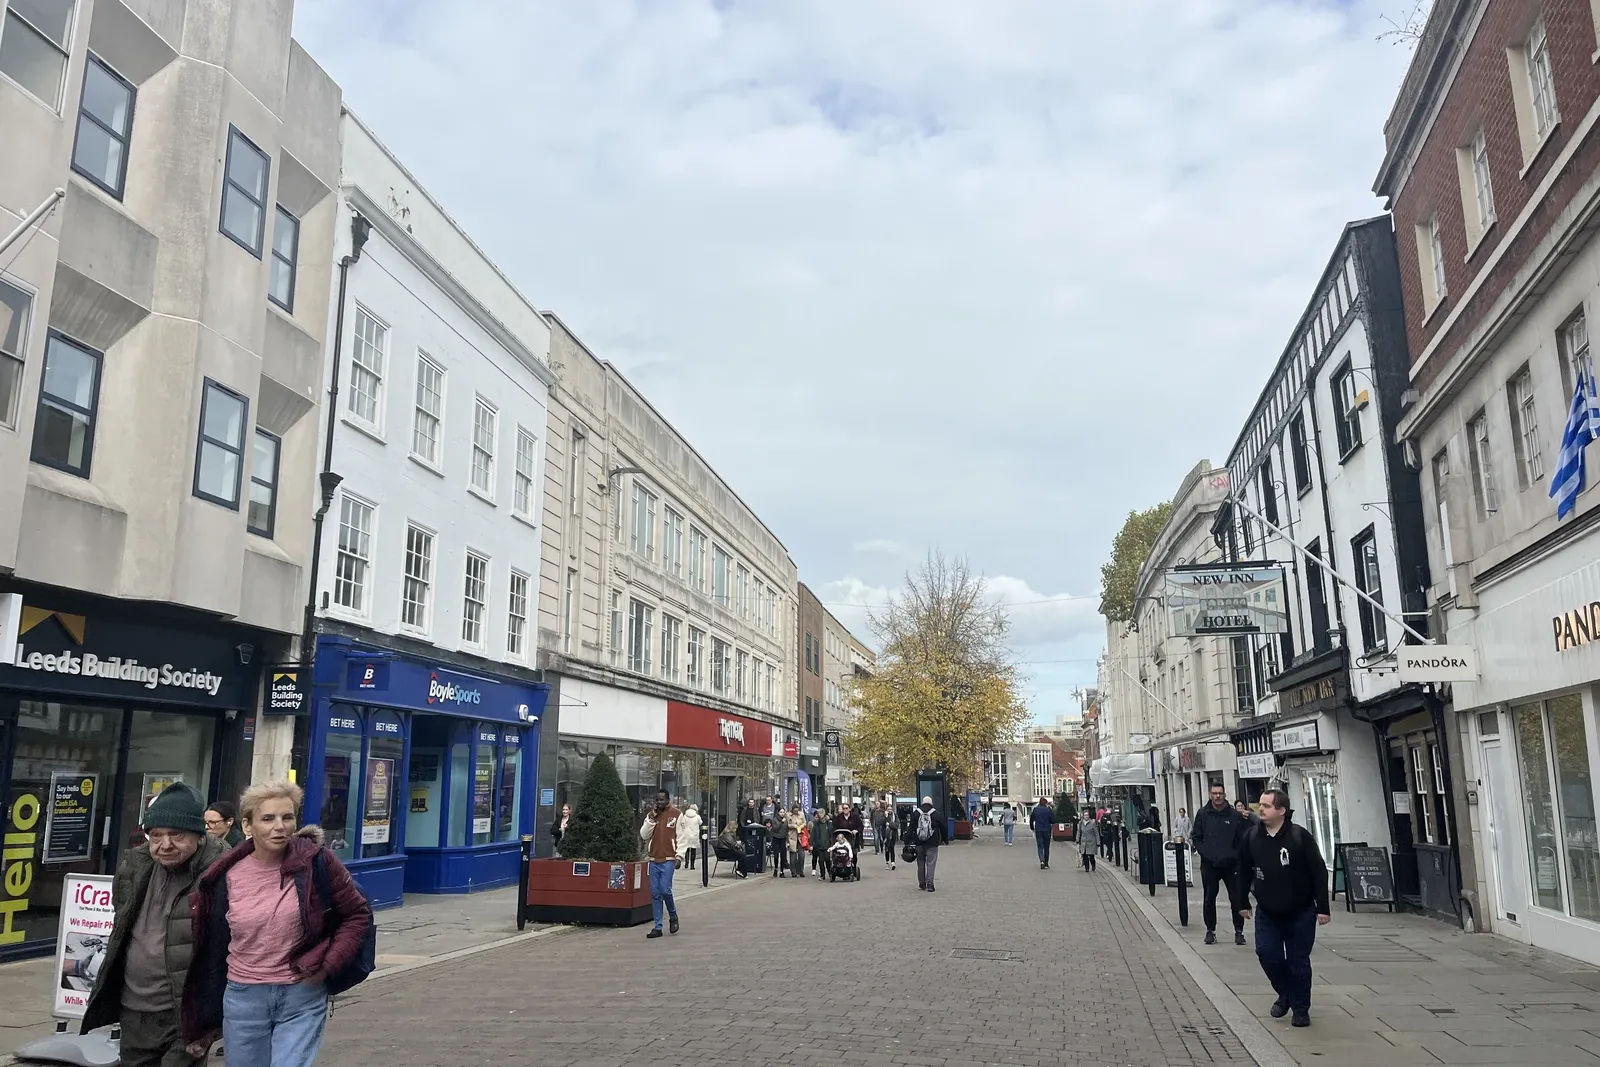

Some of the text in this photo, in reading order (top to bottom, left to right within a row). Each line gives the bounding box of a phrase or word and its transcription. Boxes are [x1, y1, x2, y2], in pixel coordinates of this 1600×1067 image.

[1192, 573, 1254, 585] NEW INN
[1203, 615, 1253, 627] HOTEL
[15, 643, 223, 696] Leeds Building Society
[272, 683, 296, 691] Leeds
[429, 680, 481, 705] BoyleSports
[1302, 684, 1317, 704] NEW
[1319, 678, 1335, 699] INN
[271, 691, 303, 701] Building
[270, 700, 301, 709] Society
[330, 717, 355, 728] BET HERE
[376, 722, 398, 732] BET HERE
[487, 734, 496, 742] HERE
[56, 785, 66, 793] Say
[0, 793, 40, 945] Hello
[75, 883, 113, 906] iCra
[70, 918, 80, 926] We
[82, 919, 103, 929] Repair
[64, 996, 83, 1005] While
